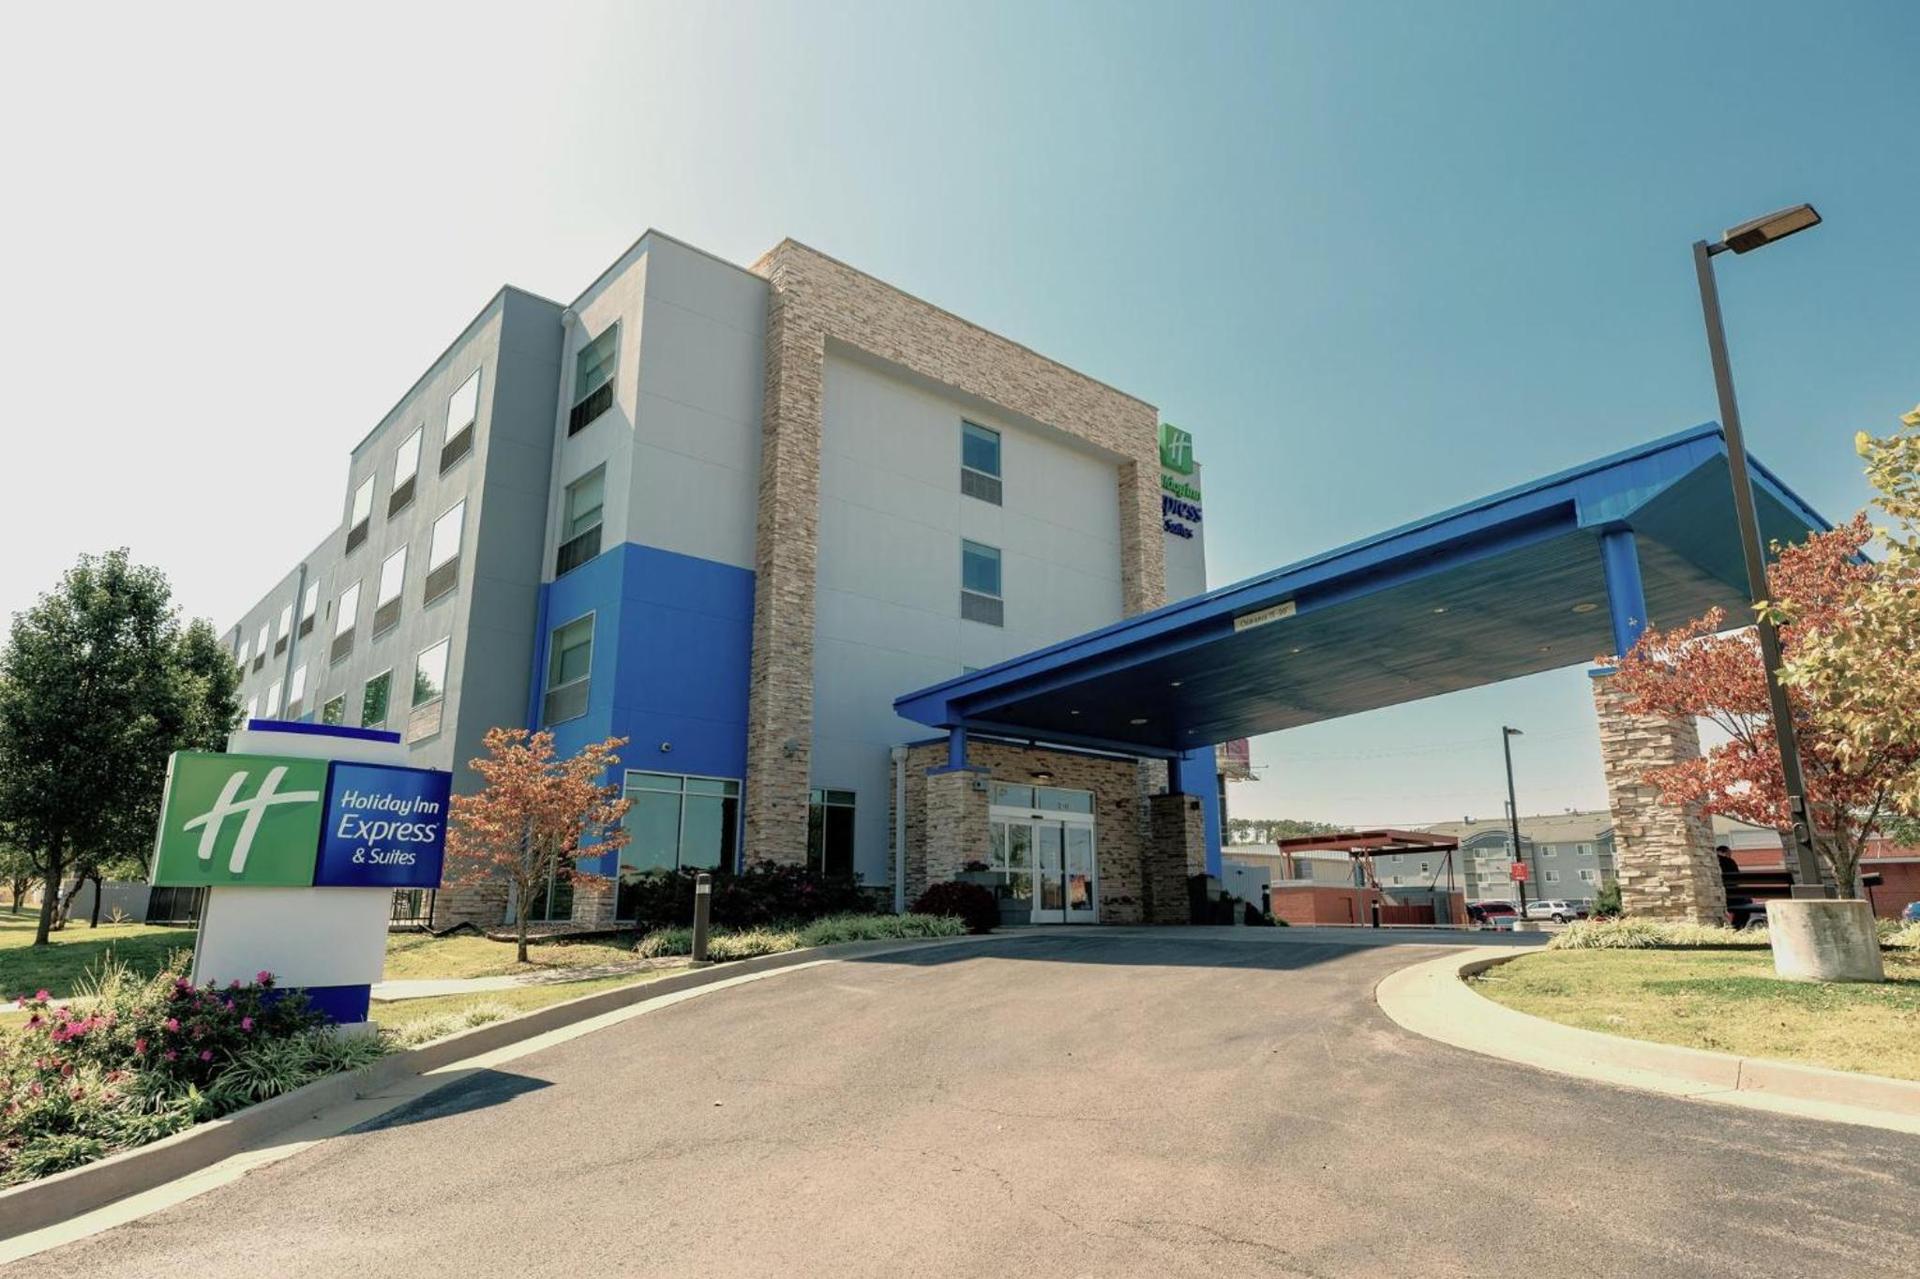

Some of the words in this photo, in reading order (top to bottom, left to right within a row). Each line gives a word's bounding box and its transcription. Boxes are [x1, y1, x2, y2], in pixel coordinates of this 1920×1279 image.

[1161, 494, 1202, 523] press
[341, 790, 412, 816] Holiday
[413, 795, 440, 814] Inn
[337, 813, 437, 846] Express
[352, 847, 366, 863] &
[368, 848, 416, 865] Suites
